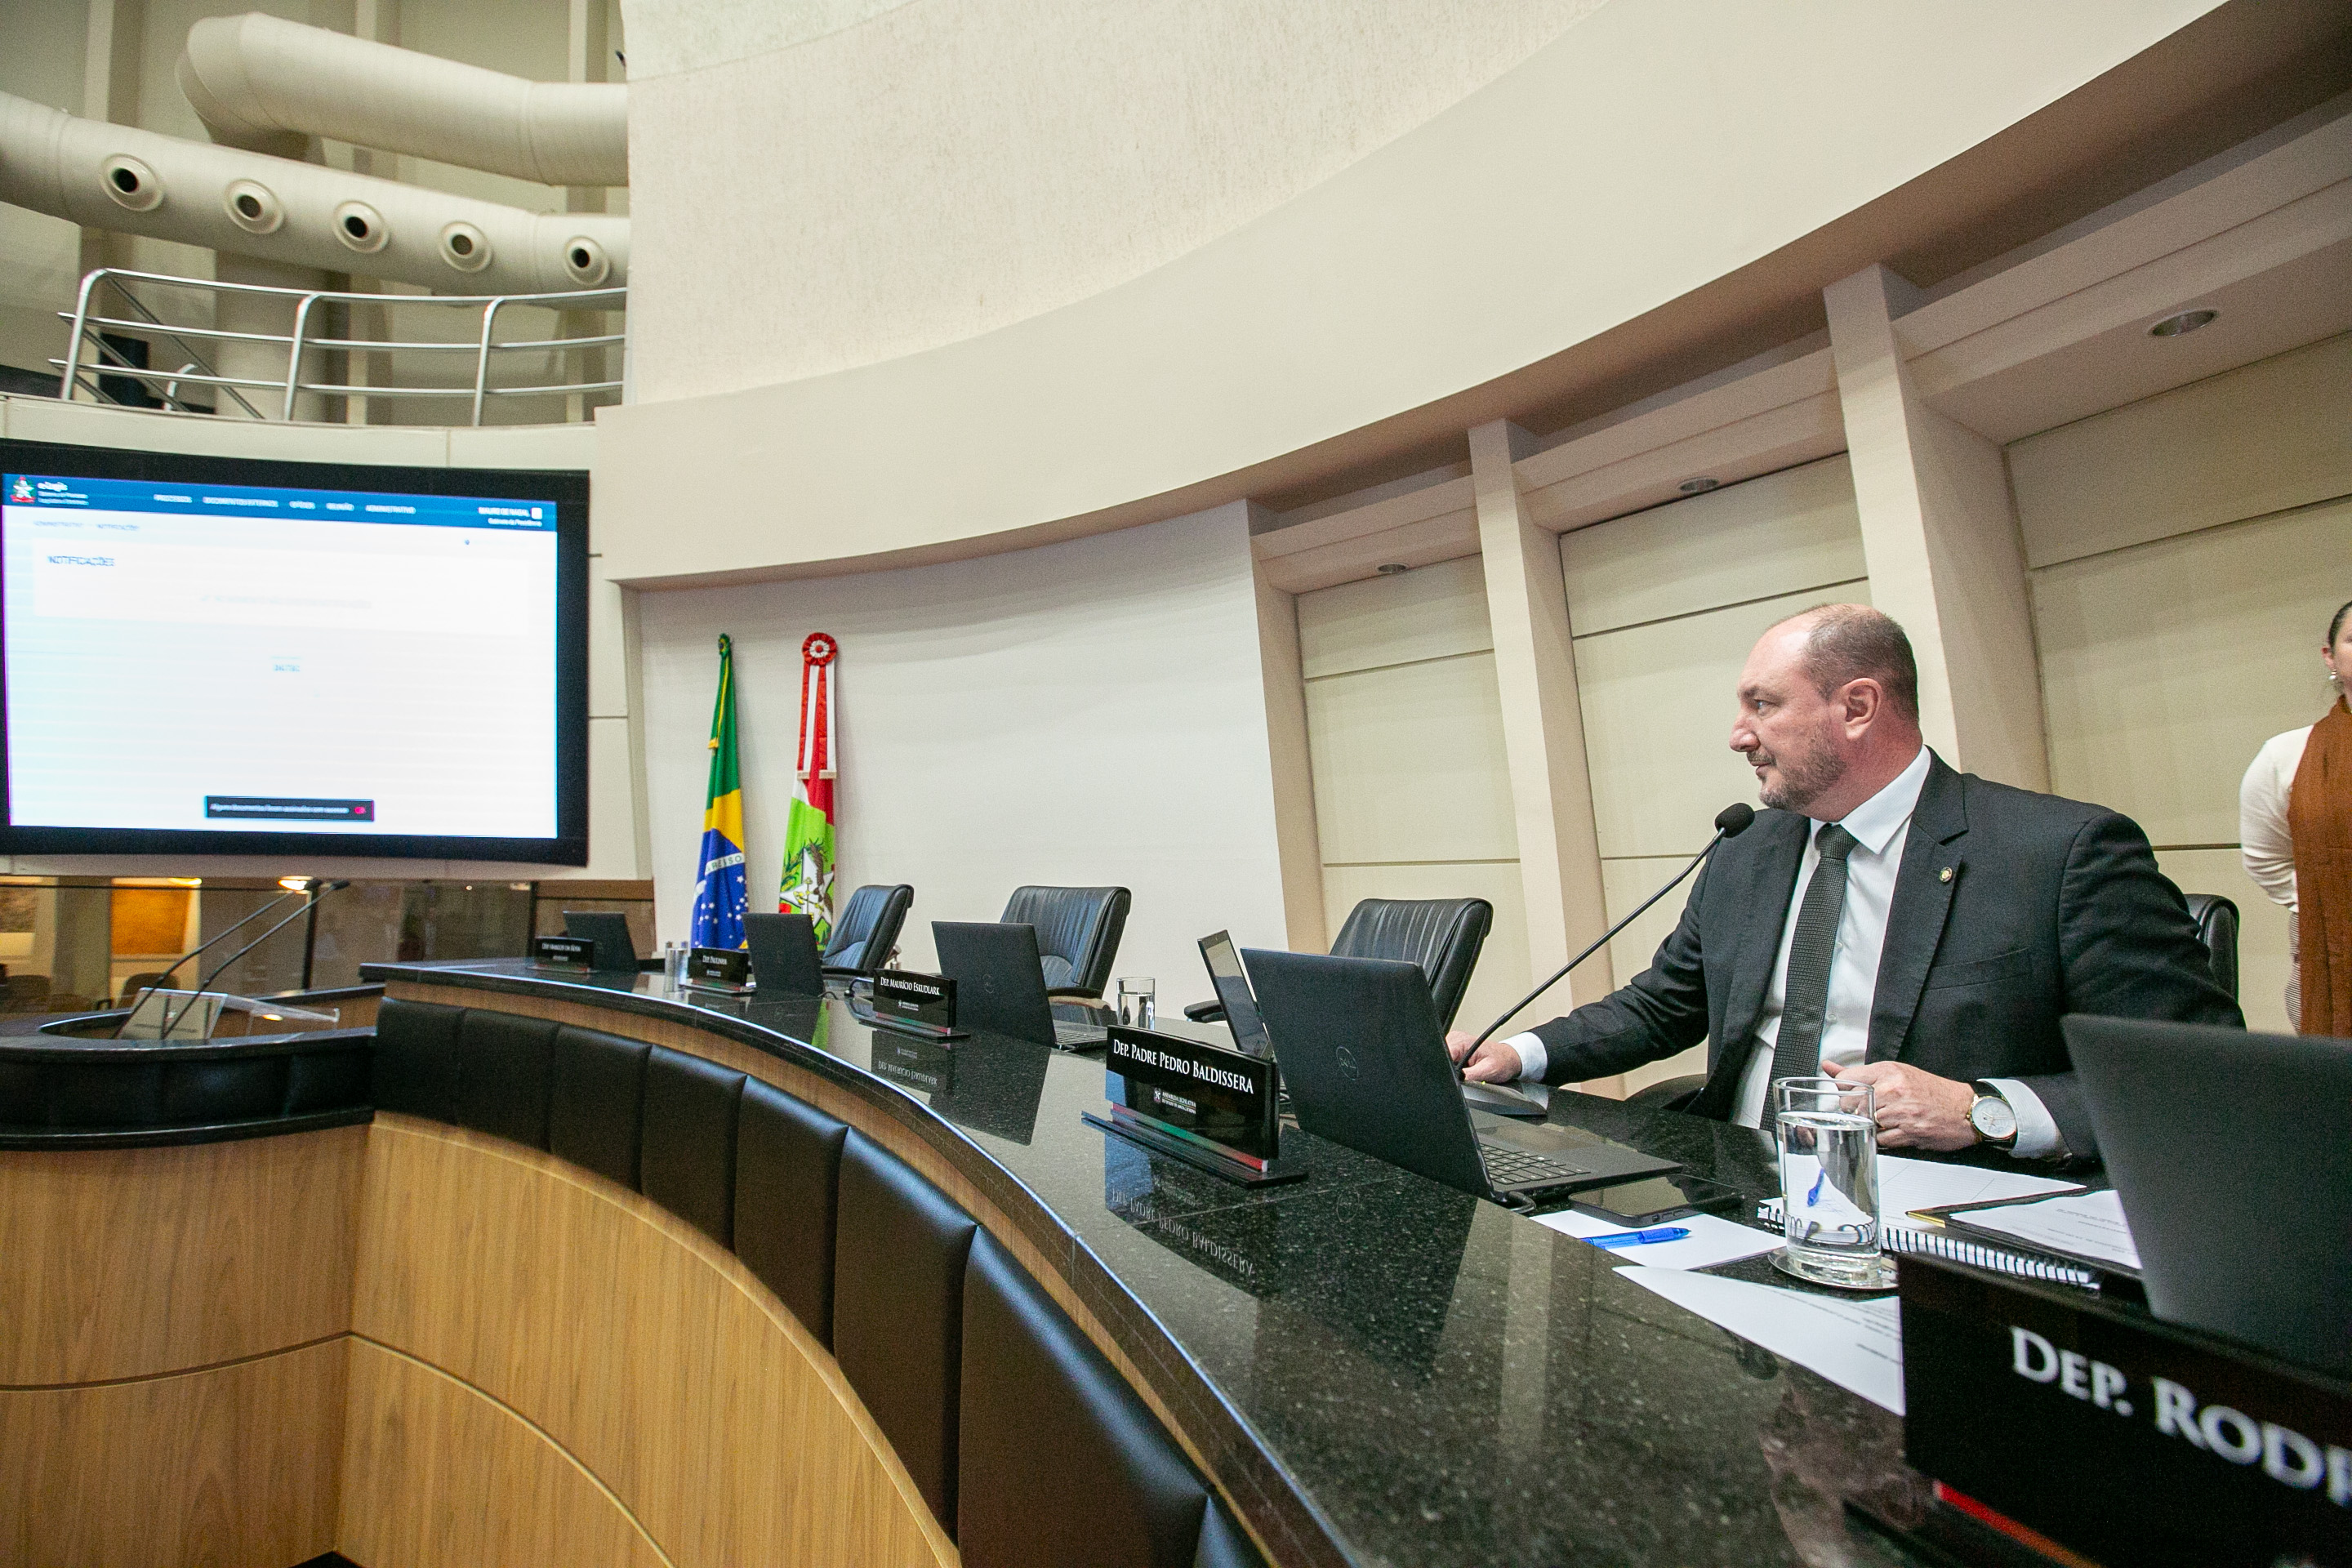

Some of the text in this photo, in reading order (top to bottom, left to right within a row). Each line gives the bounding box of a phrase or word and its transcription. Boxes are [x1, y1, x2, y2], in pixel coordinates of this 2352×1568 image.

[913, 982, 940, 996] ESKUDLARK
[1113, 1039, 1254, 1094] DEP. PADRE PEDRO BALDISSERA
[2011, 1325, 2135, 1417] DEP.
